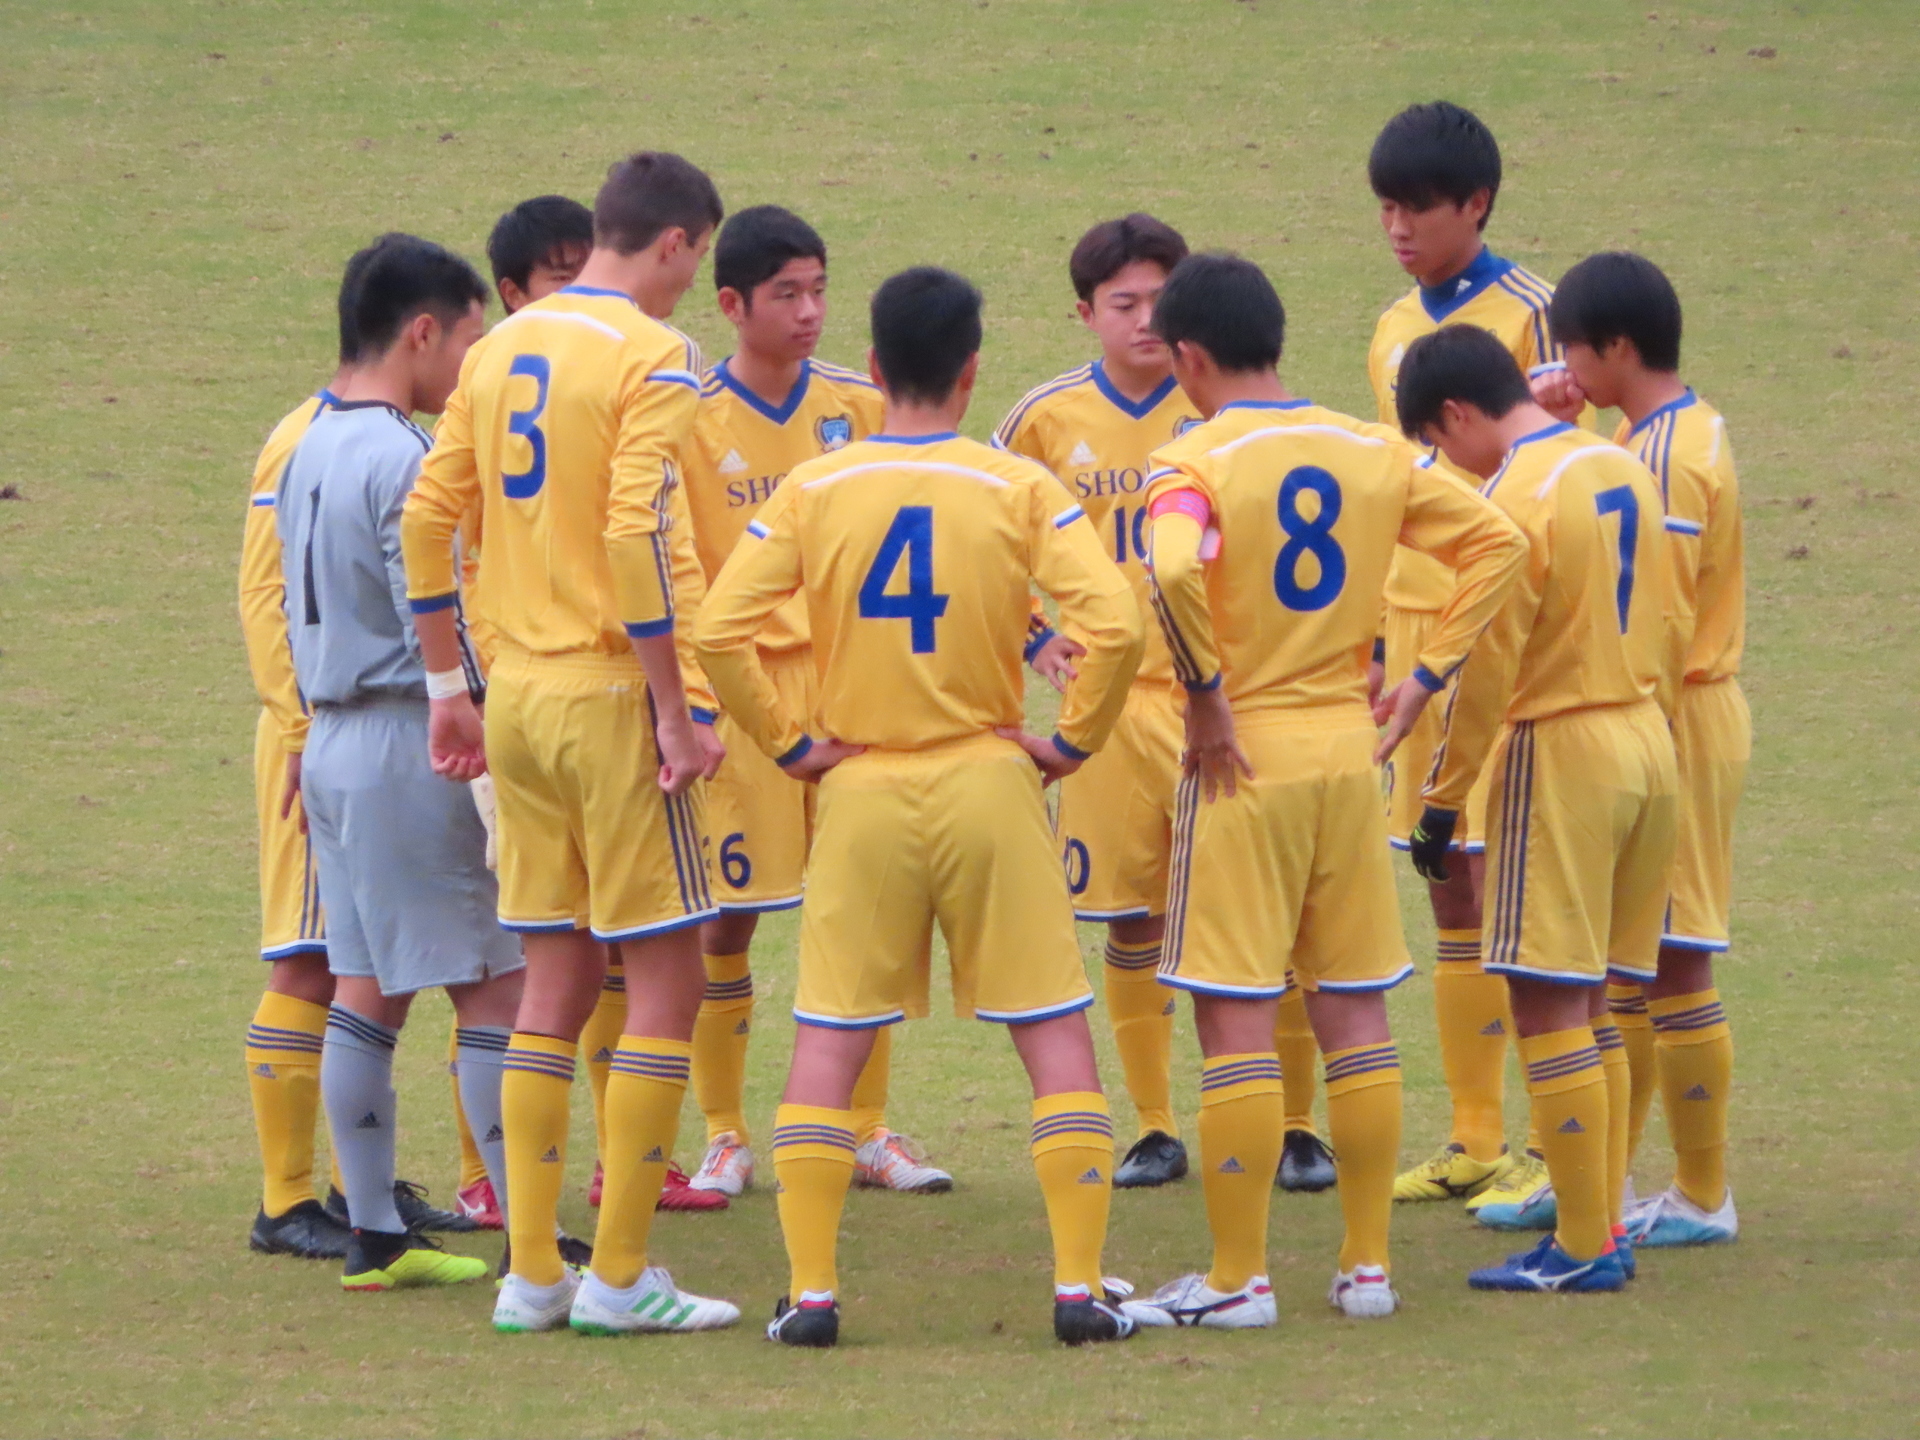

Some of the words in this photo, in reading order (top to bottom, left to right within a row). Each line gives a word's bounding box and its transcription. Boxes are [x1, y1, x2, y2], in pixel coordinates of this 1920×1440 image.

[503, 354, 551, 499] 3
[1075, 466, 1149, 499] SHO
[303, 480, 322, 626] 1
[858, 506, 949, 655] 4
[1273, 465, 1346, 612] 8
[1594, 484, 1639, 635] 7
